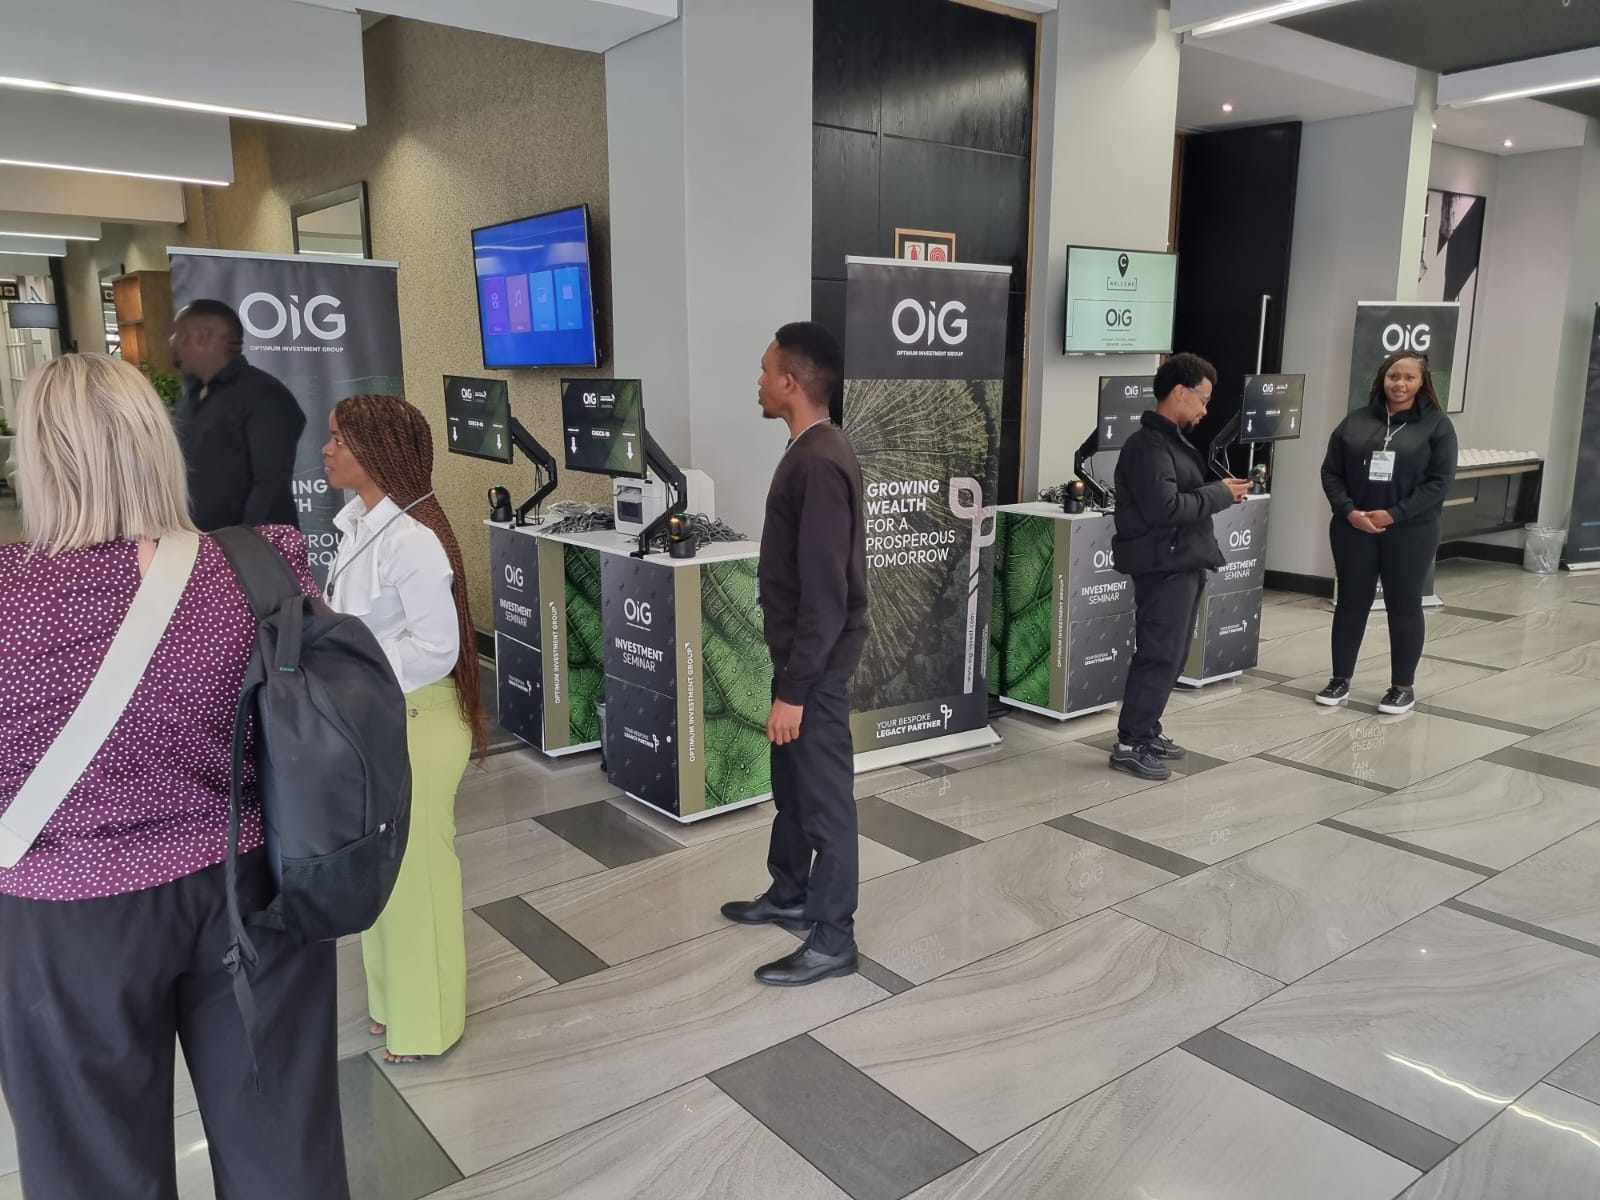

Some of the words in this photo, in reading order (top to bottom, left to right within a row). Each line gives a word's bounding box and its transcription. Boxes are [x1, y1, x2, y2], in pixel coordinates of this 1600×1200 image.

[292, 479, 328, 495] ING
[867, 479, 940, 497] GROWING
[866, 498, 927, 515] WEALTH
[866, 518, 895, 533] FOR
[898, 517, 908, 531] A
[865, 530, 956, 551] PROSPEROUS
[865, 547, 950, 569] TOMORROW
[1219, 558, 1257, 573] INVESTMENT
[1224, 569, 1250, 581] SEMINAR
[1082, 580, 1127, 596] INVESTMENT
[1088, 592, 1120, 605] SEMINAR
[499, 598, 532, 619] INVESTMENT
[505, 610, 528, 628] SEMINAR
[551, 606, 559, 630] GROUP
[552, 632, 560, 672] INVESTMENT
[615, 637, 663, 662] INVESTMENT
[623, 652, 656, 673] SEMINAR
[686, 647, 694, 675] GROUP
[687, 677, 695, 725] INVESTMENT
[876, 726, 906, 738] LEGACY
[907, 720, 941, 732] PARTNER
[877, 719, 897, 731] YOUR
[898, 713, 932, 726] BESPOKE
[688, 725, 696, 762] OPTIMUM
